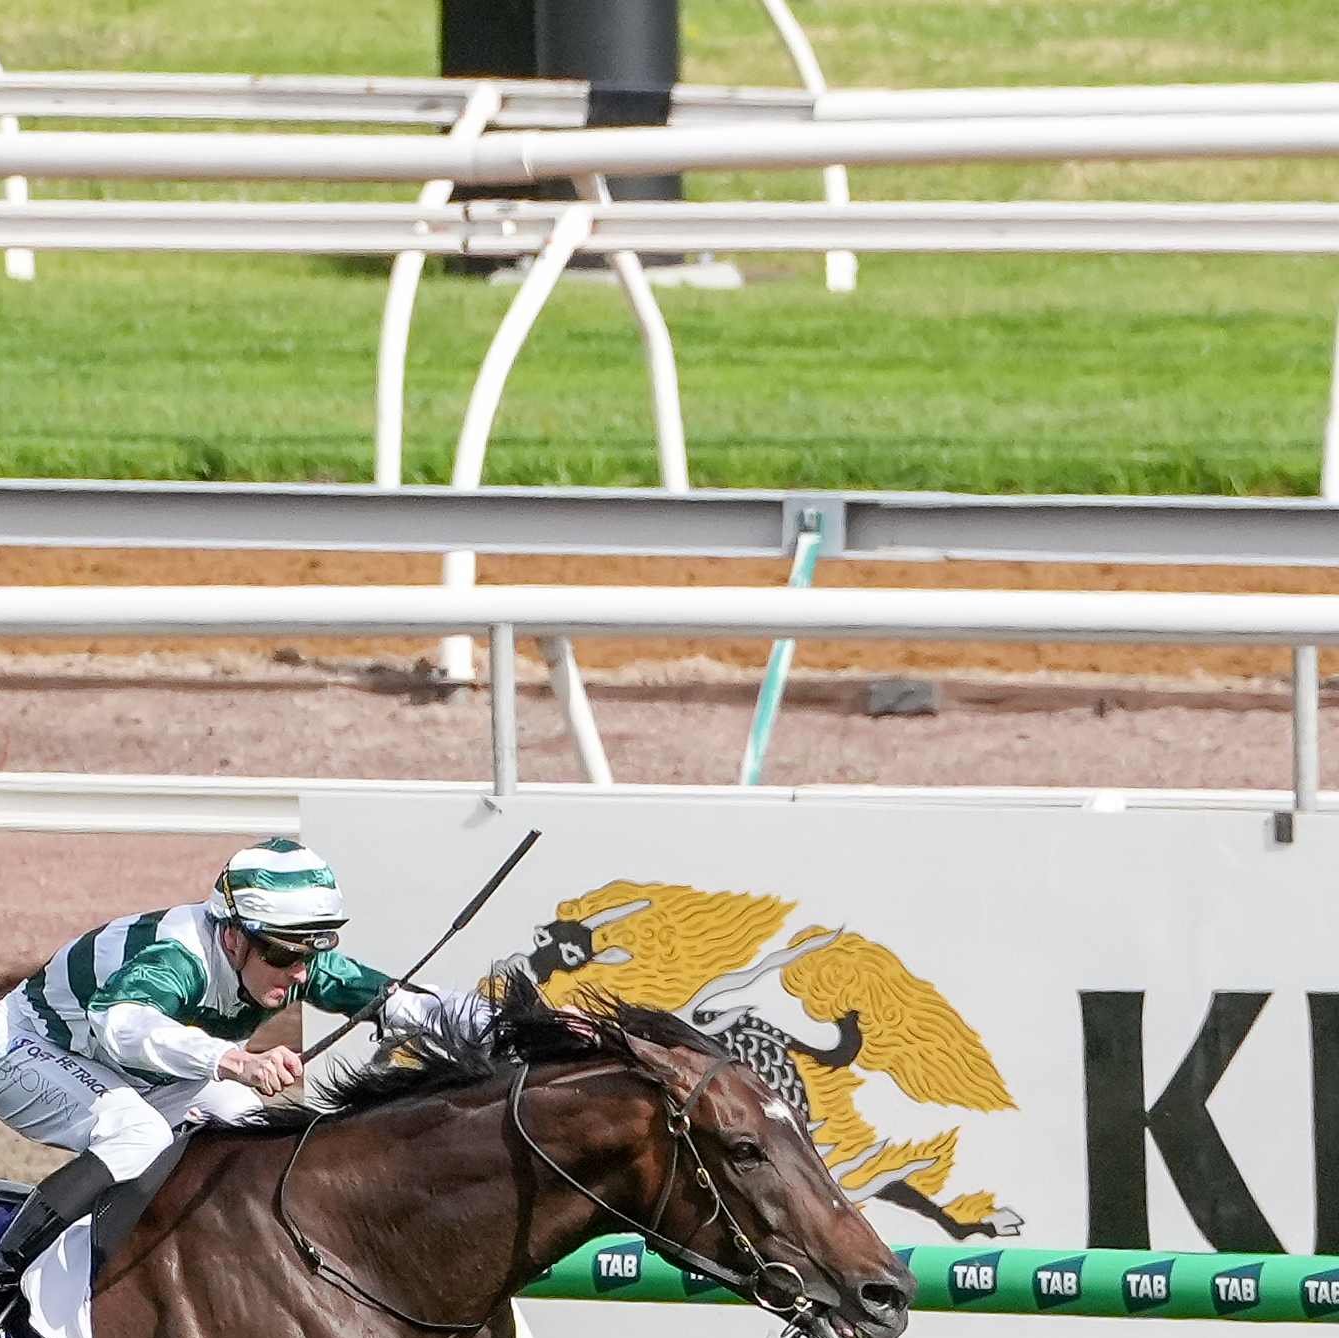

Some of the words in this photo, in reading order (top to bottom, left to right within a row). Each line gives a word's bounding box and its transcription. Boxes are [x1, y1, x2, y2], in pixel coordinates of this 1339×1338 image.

[71, 1068, 111, 1098] TRACK
[597, 1253, 638, 1278] TAB
[952, 1264, 993, 1290] TAB
[1036, 1270, 1078, 1296] TAB
[1125, 1272, 1167, 1299] TAB
[1214, 1275, 1256, 1302] TAB
